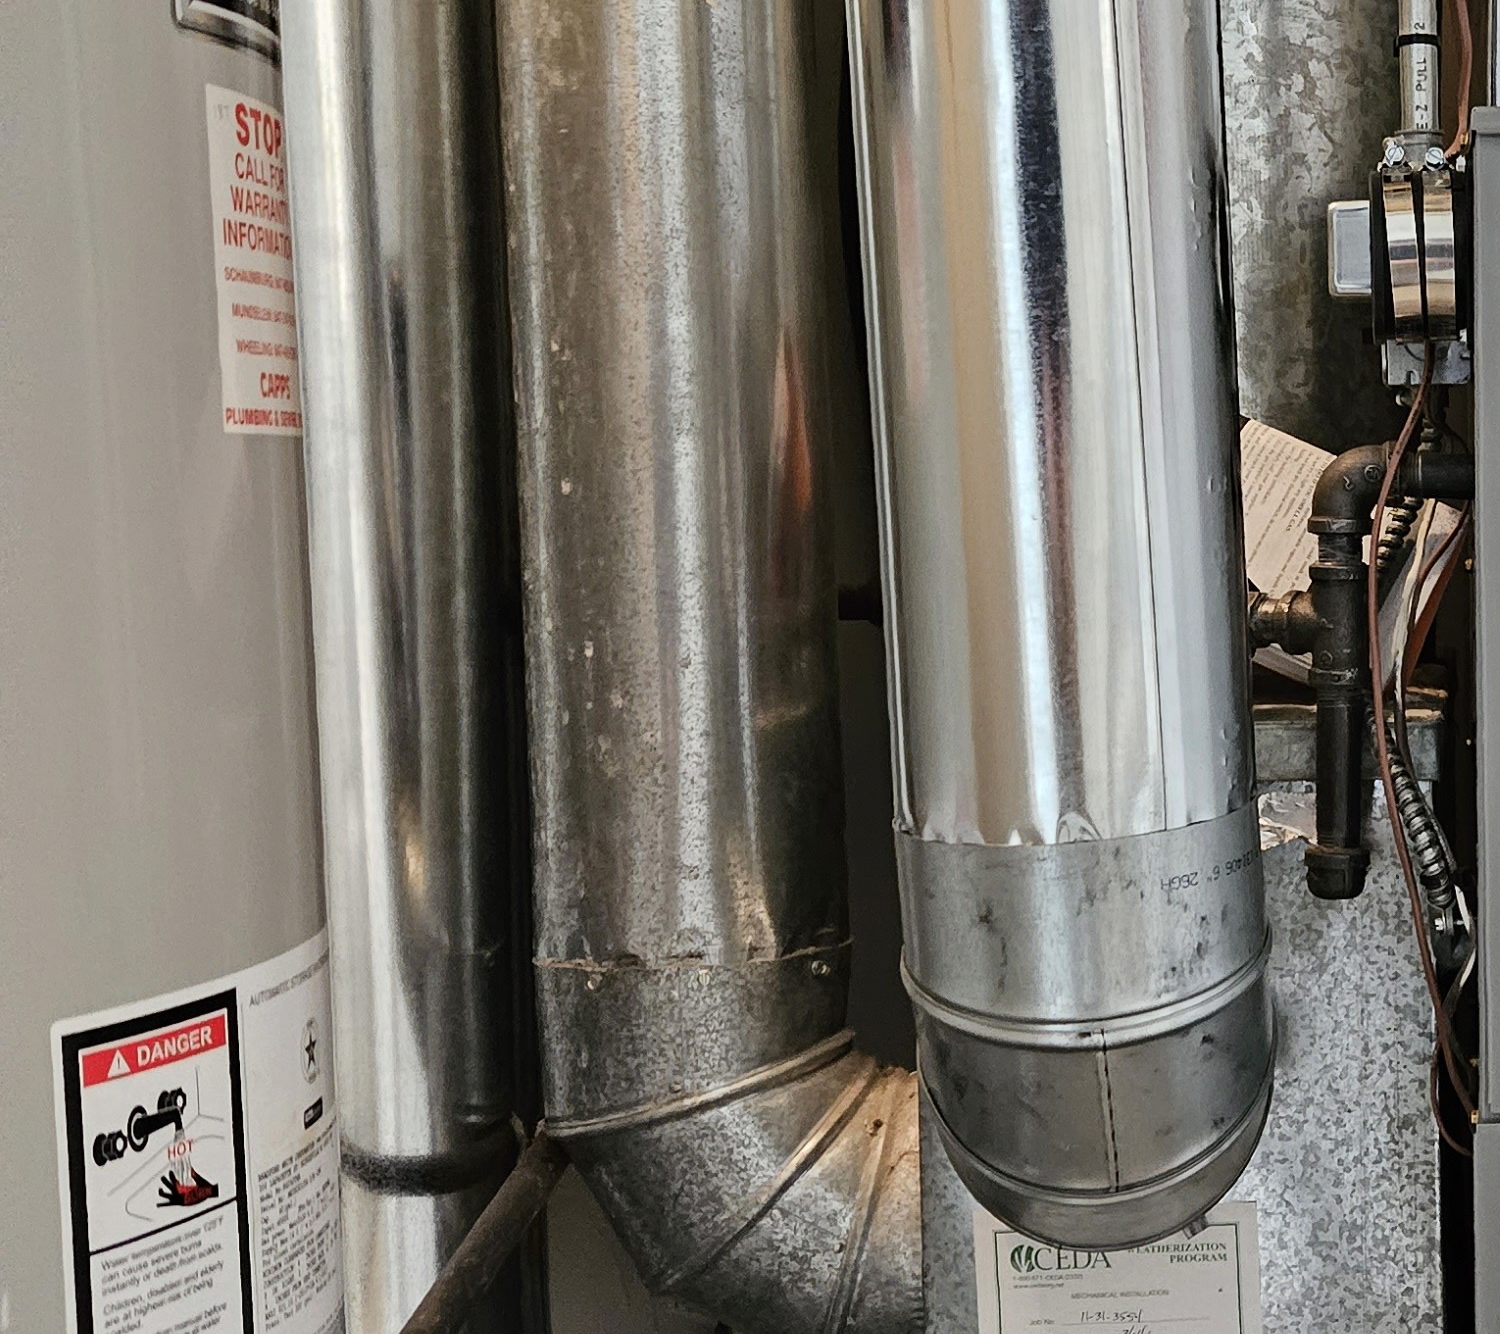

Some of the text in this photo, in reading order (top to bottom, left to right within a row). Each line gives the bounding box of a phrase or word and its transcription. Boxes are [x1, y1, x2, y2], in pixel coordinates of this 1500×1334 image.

[1415, 57, 1428, 92] PULL
[235, 101, 282, 158] STOP
[234, 152, 268, 186] CALL
[136, 1025, 213, 1067] DANGER
[167, 1139, 194, 1159] HOT
[1034, 1246, 1113, 1271] CEDA
[1169, 1253, 1228, 1264] PROGRAM
